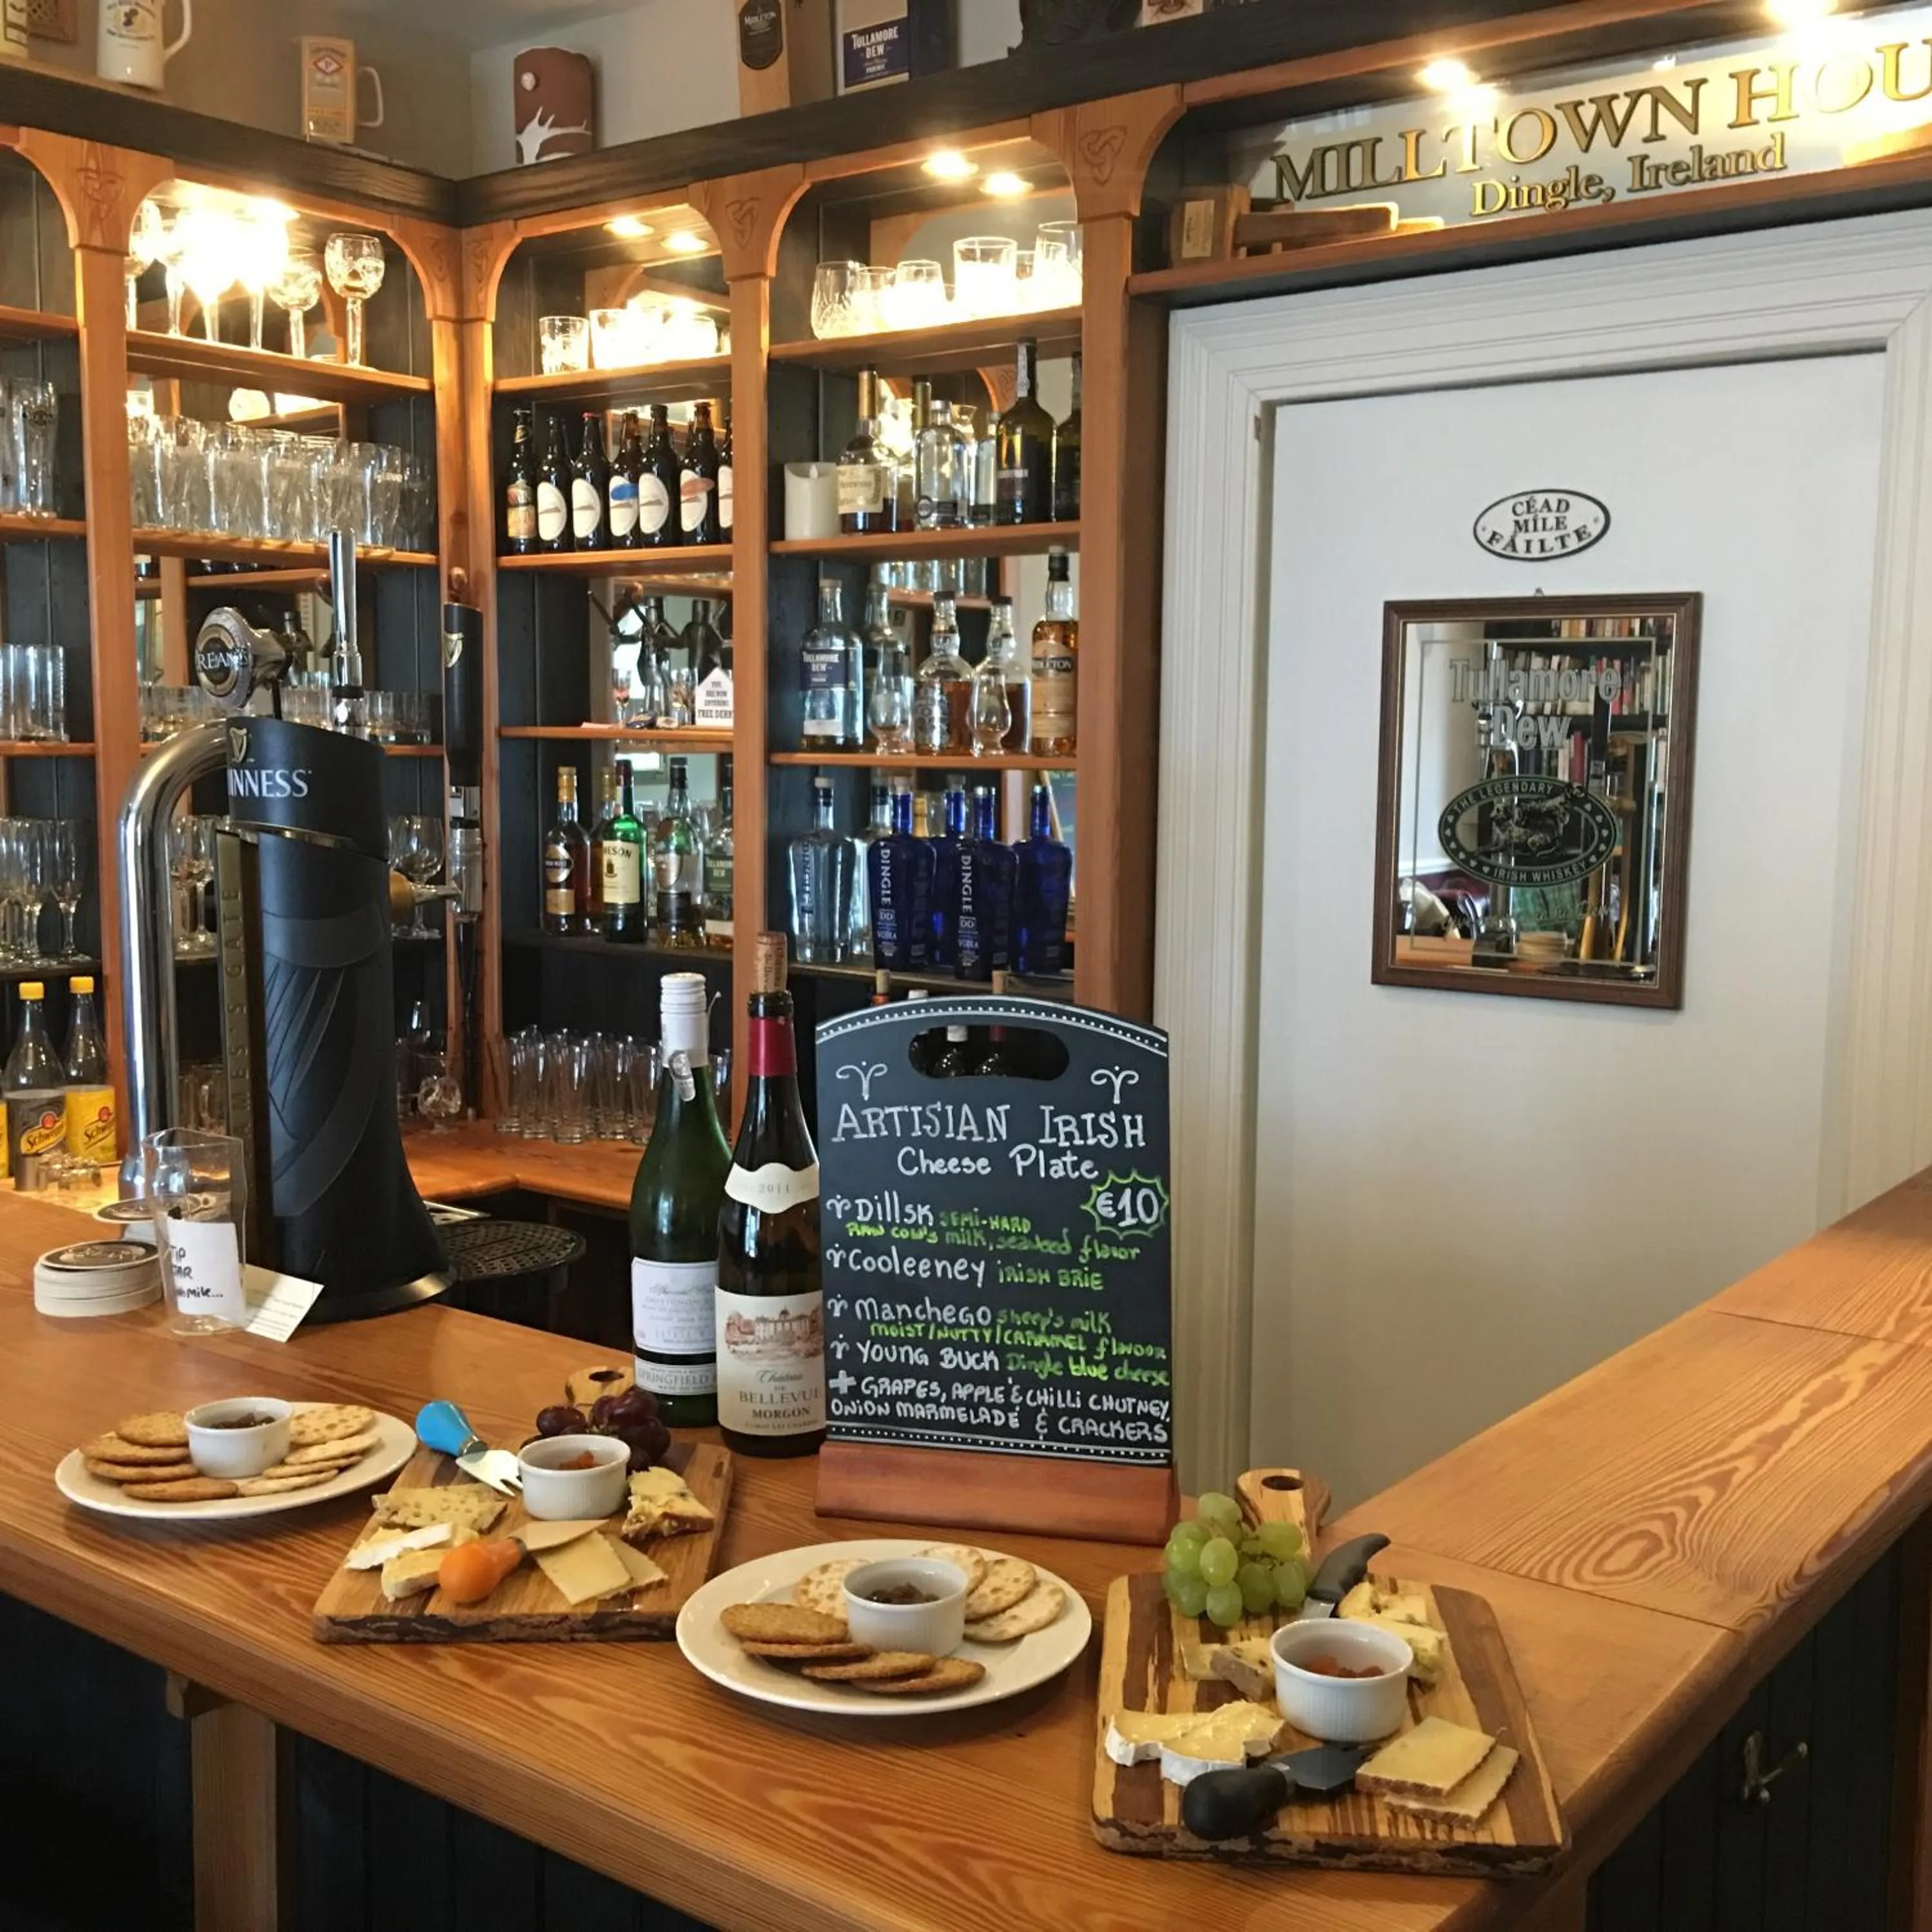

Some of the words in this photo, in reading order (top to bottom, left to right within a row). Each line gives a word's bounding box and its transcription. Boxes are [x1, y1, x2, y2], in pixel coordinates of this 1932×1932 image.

[851, 26, 899, 50] TULLAMORE
[866, 43, 885, 59] DEW
[1270, 77, 1709, 204] MILLTOWN
[1470, 165, 1615, 218] Dingle,
[1627, 131, 1786, 193] Ireland
[1511, 495, 1571, 516] CÉAD
[1449, 658, 1622, 704] Tullamore
[1490, 705, 1572, 751] Dew
[227, 768, 308, 797] INNESS
[1454, 792, 1478, 814] THE
[1480, 781, 1554, 800] LEGENDARY
[880, 849, 892, 906] DINGLE
[961, 855, 972, 913] DINGLE
[1493, 867, 1528, 882] IRISH
[1533, 860, 1587, 882] WHISKEY
[831, 1103, 1010, 1142] ARTISIAN
[1038, 1105, 1146, 1149] IRISH
[897, 1146, 992, 1176] Cheese
[1009, 1143, 1099, 1179] Plate
[1096, 1188, 1159, 1227] €10
[849, 1246, 985, 1287] Cooleeney
[940, 1347, 999, 1372] BUCK
[1068, 1356, 1109, 1381] blue
[861, 1376, 947, 1403] GRAPES,
[952, 1382, 1005, 1404] APPLE
[752, 1406, 811, 1419] MORGON
[1058, 1416, 1168, 1443] CRACKERS
